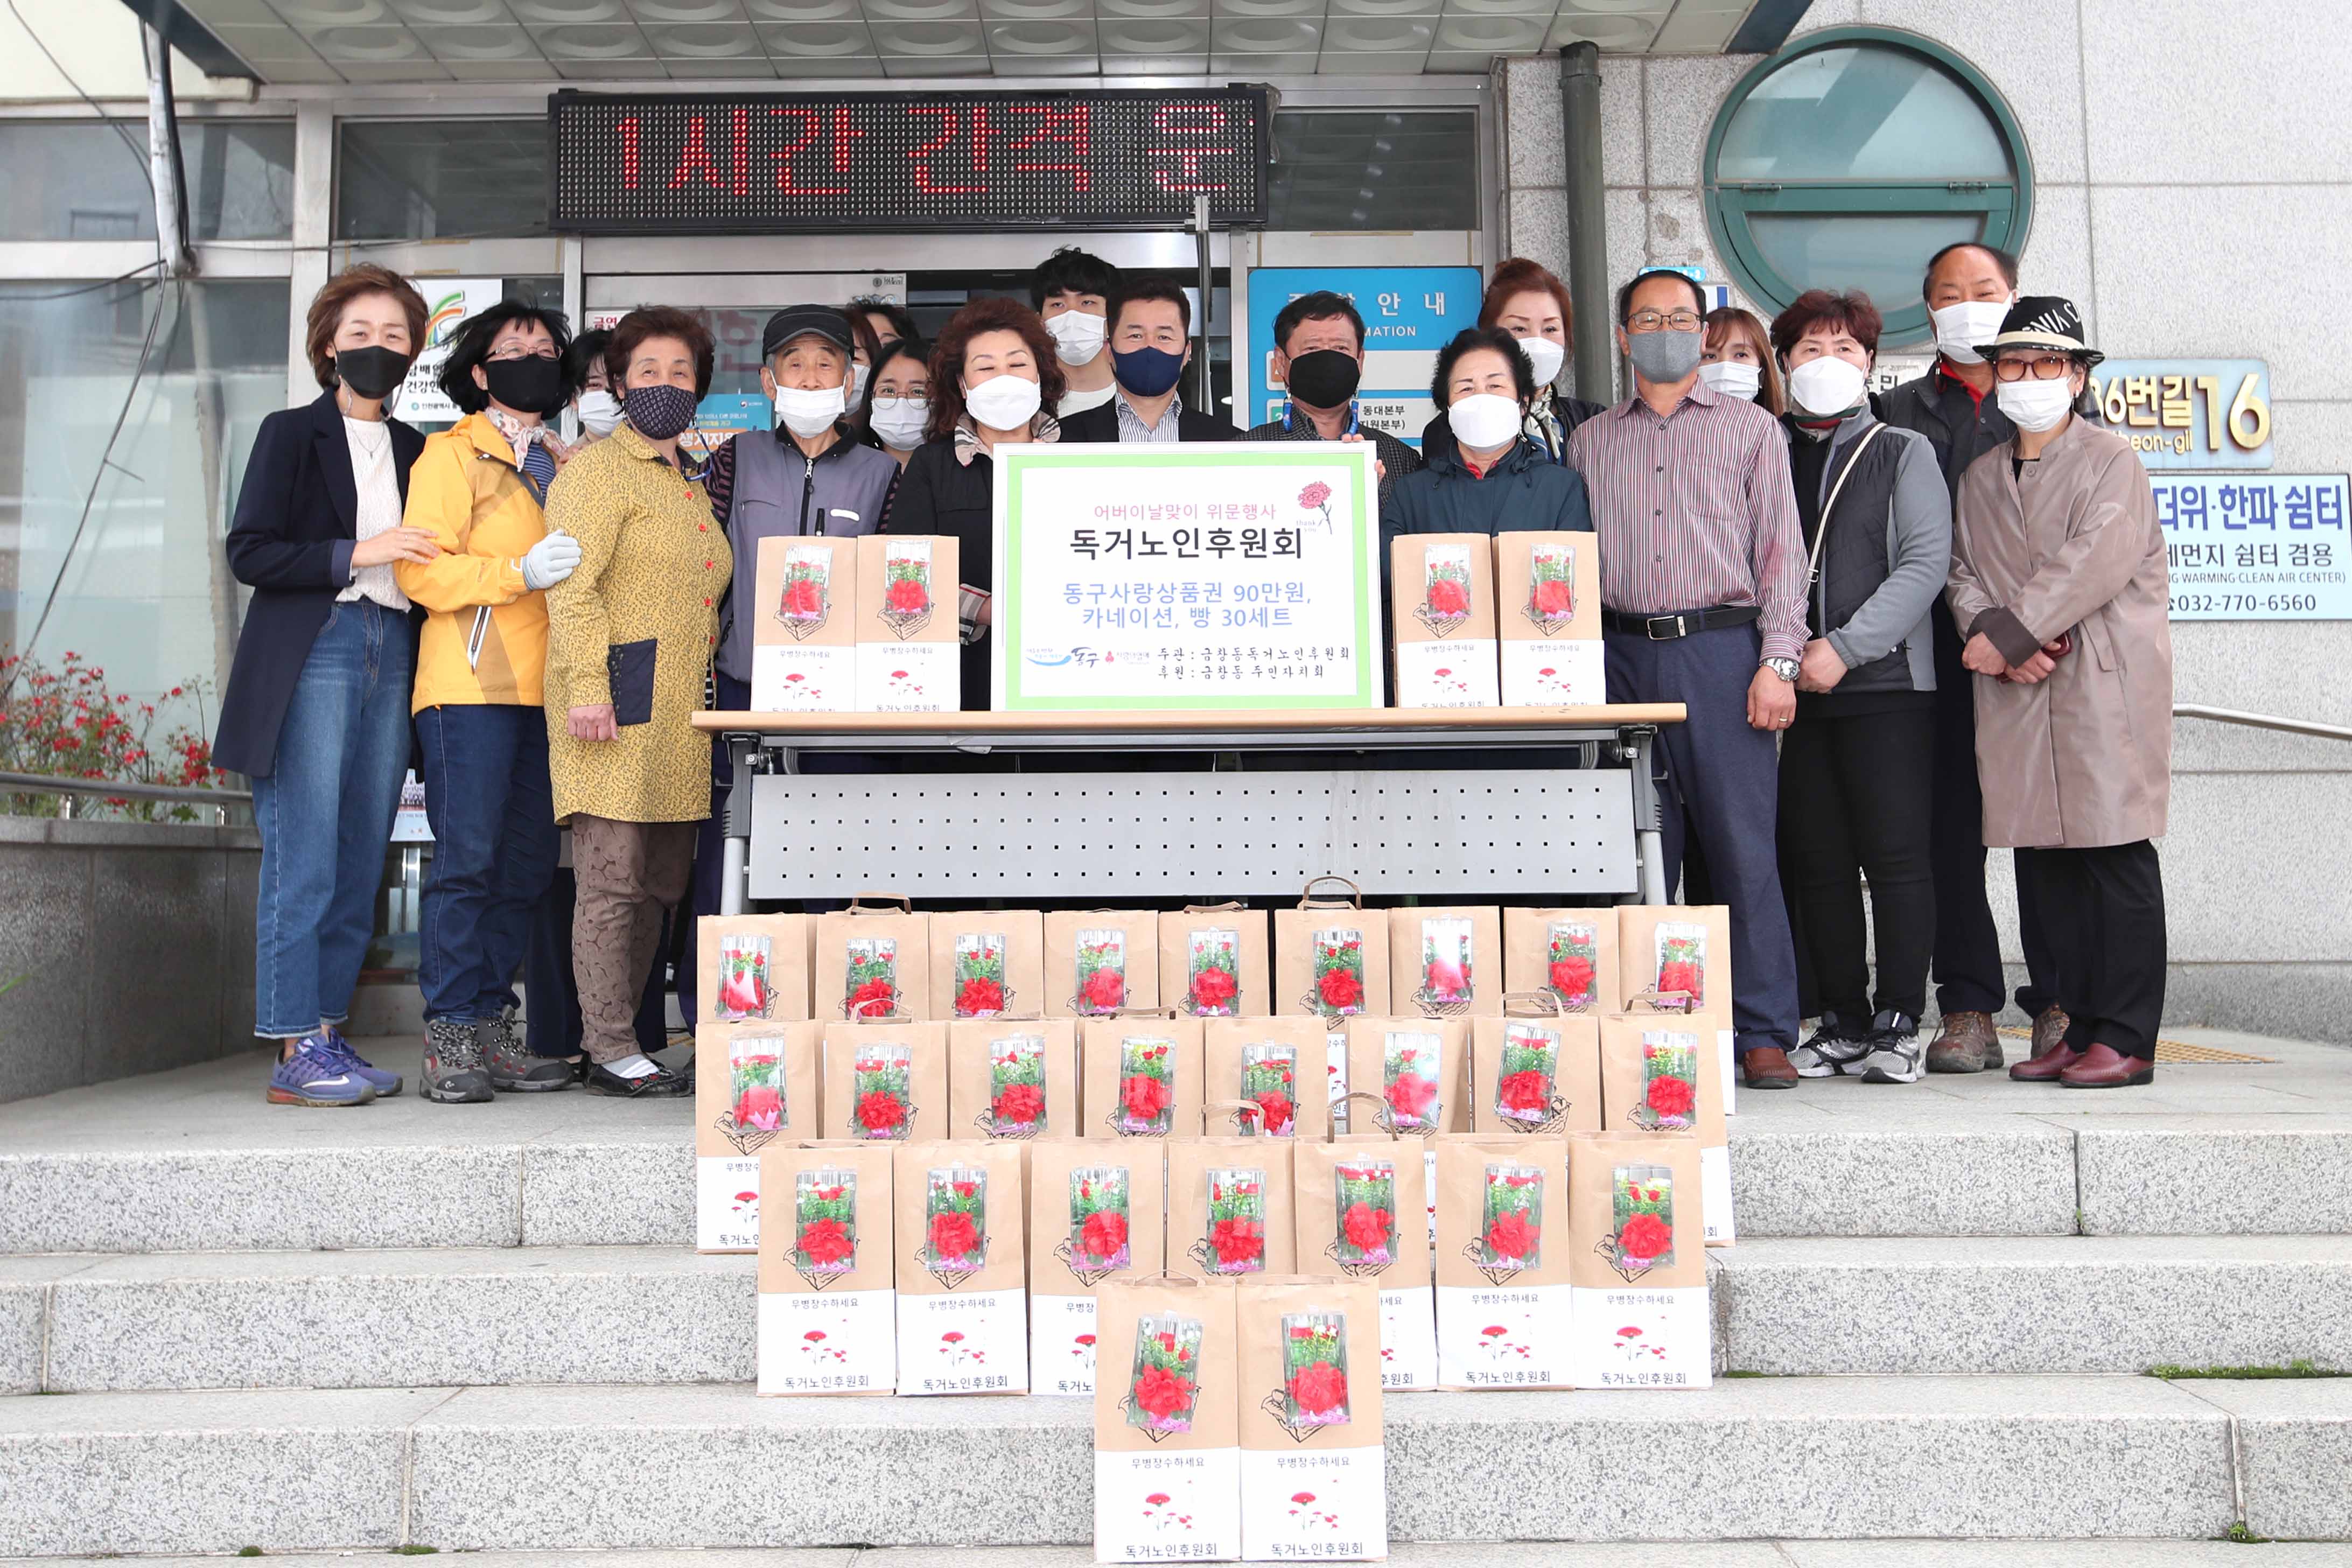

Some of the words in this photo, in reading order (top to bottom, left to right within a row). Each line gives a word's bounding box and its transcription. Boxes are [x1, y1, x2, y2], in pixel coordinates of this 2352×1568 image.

[616, 107, 865, 195] 1시간
[907, 105, 1089, 193] 간격
[2197, 373, 2271, 450] 16
[1094, 503, 1198, 521] 어버이날맞이
[1207, 503, 1276, 520] 위문행사
[2285, 485, 2343, 530] 쉼터
[1069, 528, 1303, 560] 독거노인후원회
[2235, 543, 2278, 567] 쉼터
[2288, 543, 2333, 567] 겸용
[2278, 572, 2296, 583] AIR
[2299, 572, 2346, 584] CENTER)
[1063, 582, 1222, 605] 동구사랑상품권
[1234, 582, 1312, 605] 90만원,
[2178, 594, 2316, 612] 032-770-6560
[1083, 607, 1179, 629] 카네이션,
[1189, 607, 1211, 628] 빵
[1222, 607, 1293, 628] 30세트
[792, 1298, 858, 1310] 무병장수하세요
[928, 1298, 996, 1311] 무병장수하세요
[1472, 1293, 1538, 1305] 무병장수하세요
[1607, 1295, 1675, 1306] 무병장수하세요
[785, 1375, 869, 1389] 독거노인후원회
[923, 1375, 1009, 1390] 독거노인후원회
[1465, 1371, 1551, 1384] 독거노인후원회
[1601, 1372, 1686, 1385] 독거노인후원회
[1131, 1457, 1205, 1469] 무병장수하세요
[1277, 1457, 1350, 1469] 무병장수하세요
[1125, 1544, 1217, 1558] 독거노인후원회
[1271, 1542, 1363, 1557] 독거노인후원회
